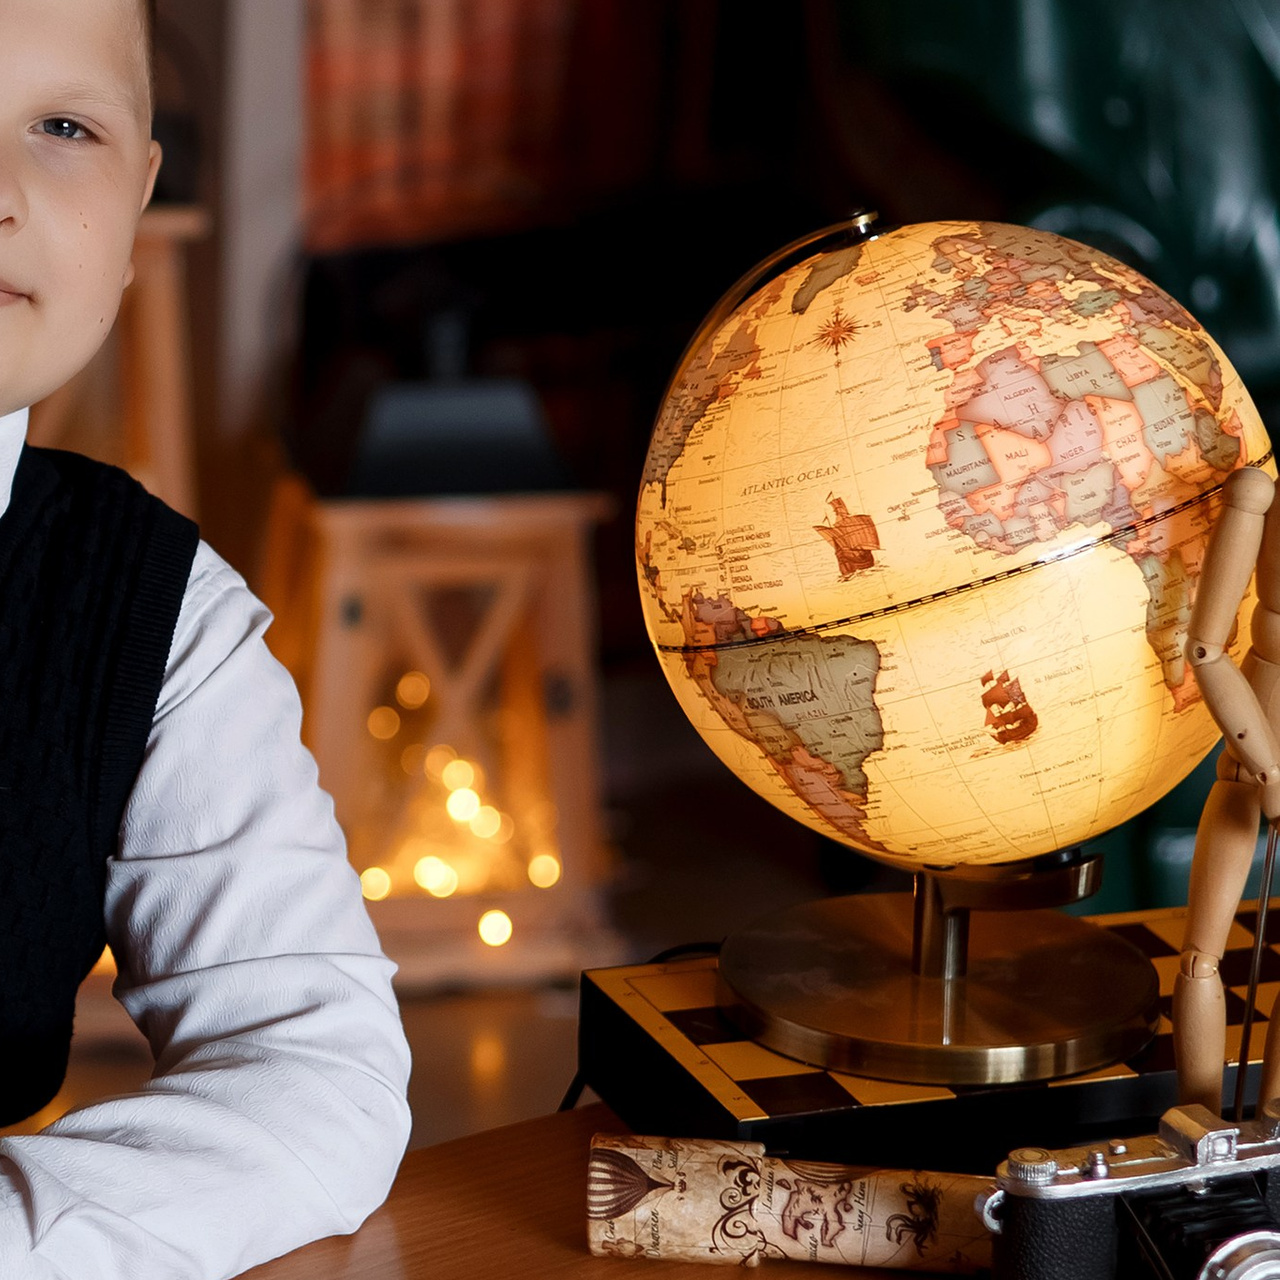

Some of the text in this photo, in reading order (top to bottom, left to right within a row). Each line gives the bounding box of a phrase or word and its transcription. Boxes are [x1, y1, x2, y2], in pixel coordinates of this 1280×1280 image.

[1066, 369, 1090, 382] LIBYA
[1003, 386, 1037, 401] ALGERIA
[1116, 434, 1137, 449] CHAD
[1005, 449, 1029, 460] MALI
[1060, 445, 1085, 460] NIGER
[946, 458, 993, 478] MAURITANIA
[740, 464, 841, 497] ATLANTIC OCEAN
[747, 689, 819, 710] SOUTH AMERICA
[795, 708, 828, 720] BRAZIL
